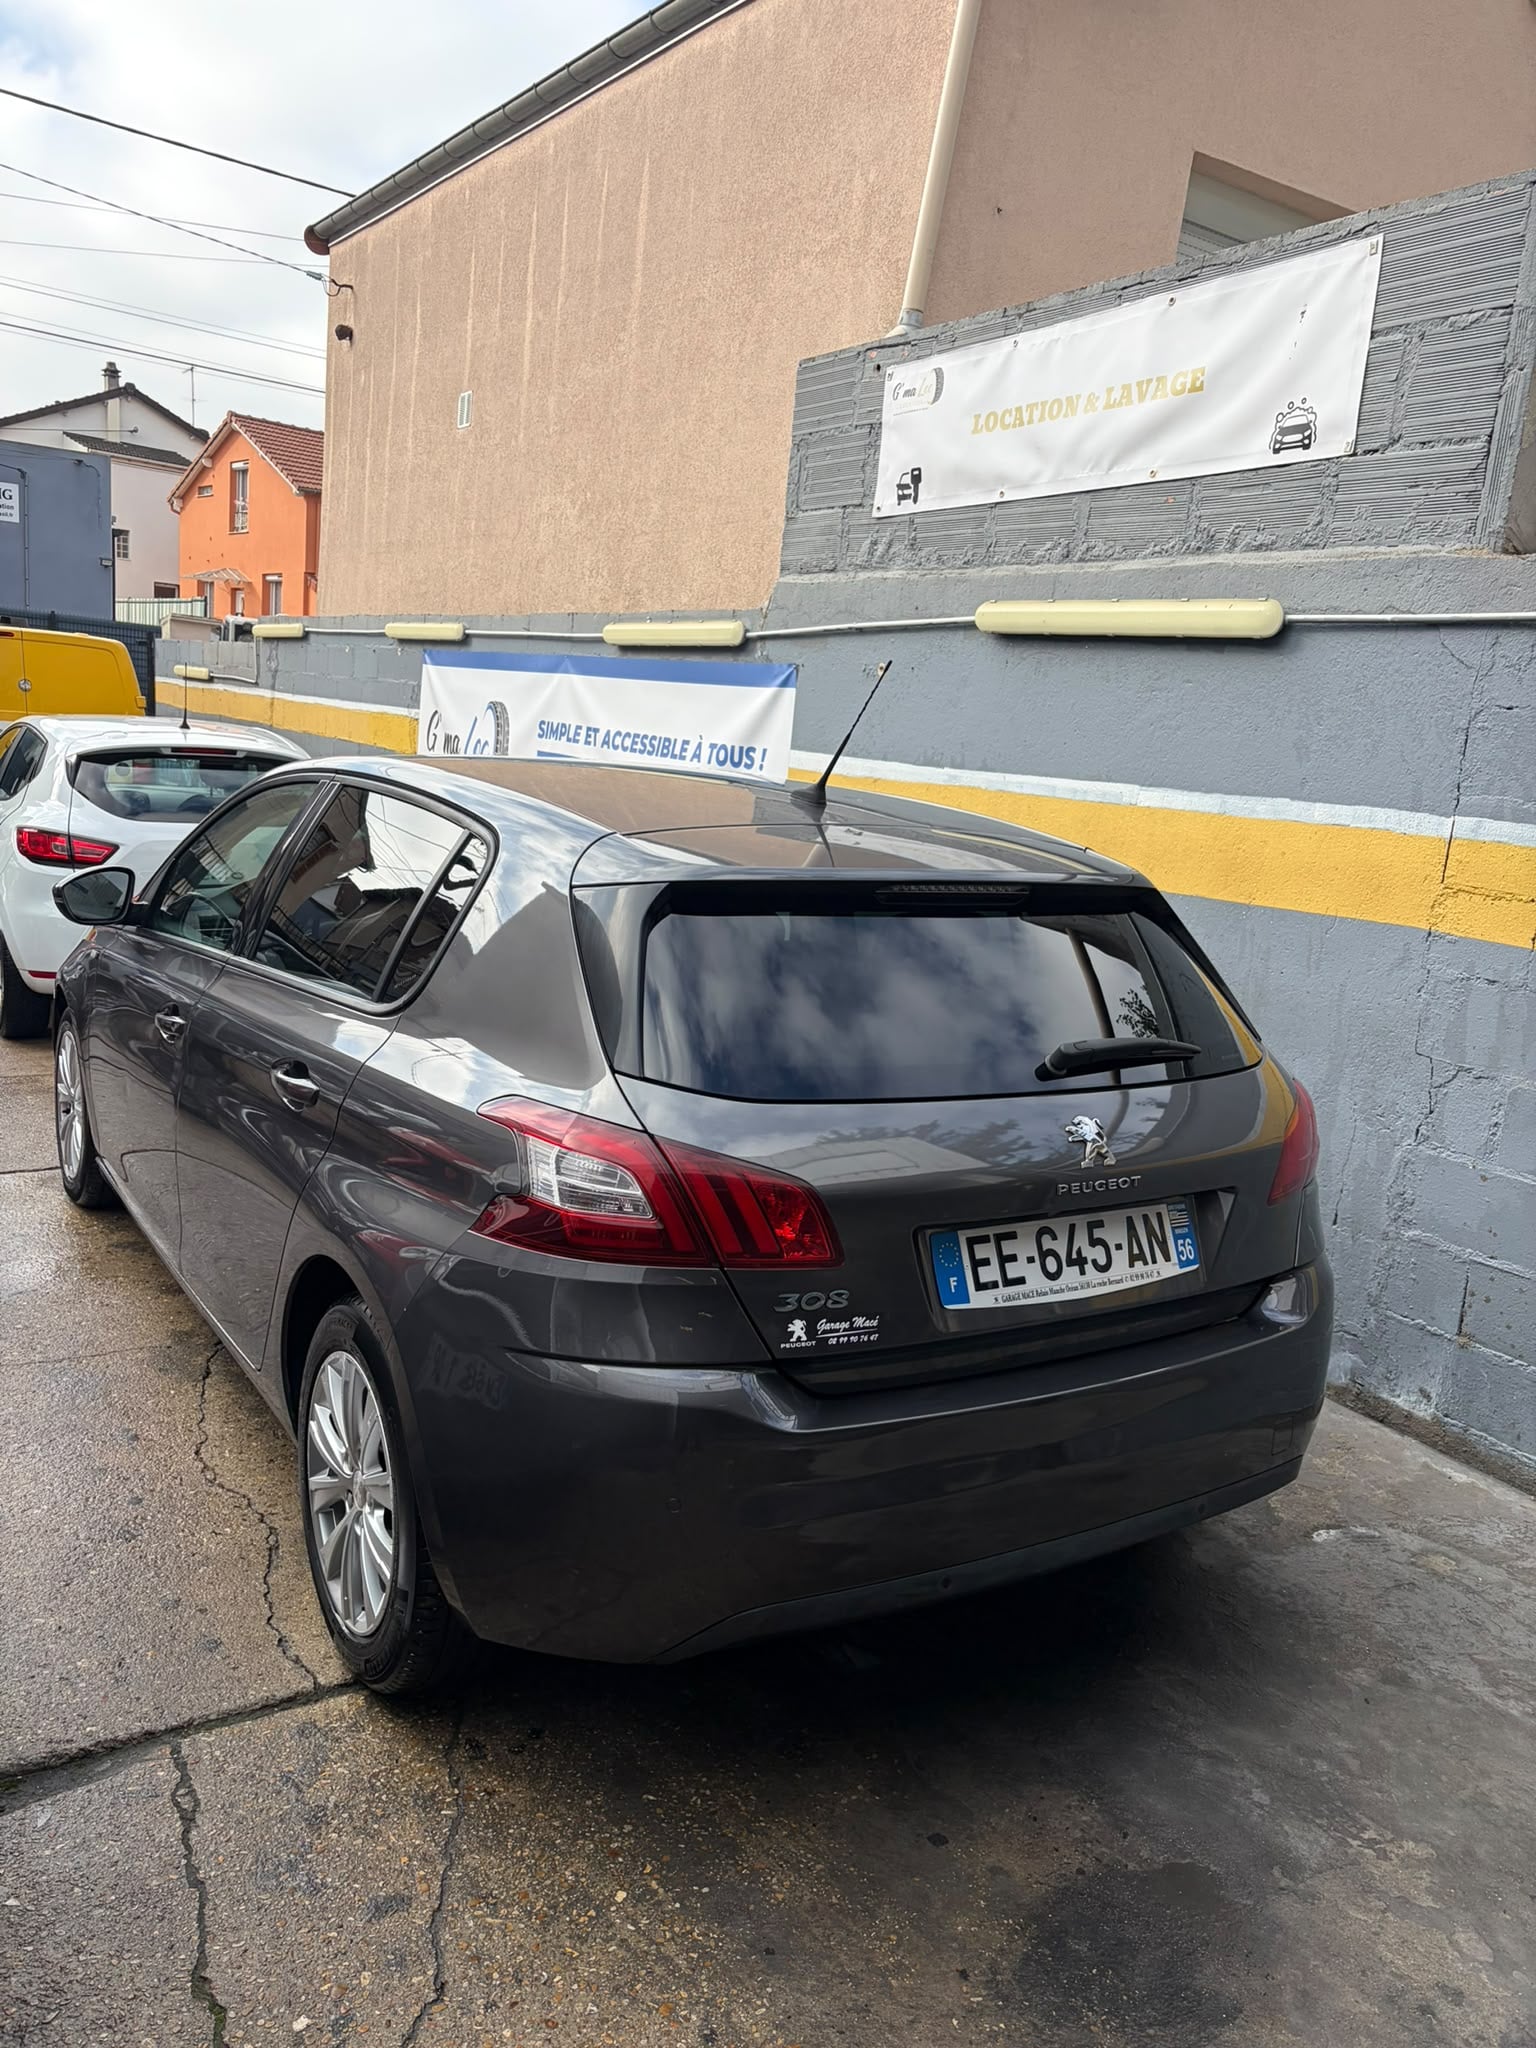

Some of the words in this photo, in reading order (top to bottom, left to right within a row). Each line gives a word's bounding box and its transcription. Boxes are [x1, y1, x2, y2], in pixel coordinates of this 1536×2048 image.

[971, 393, 1082, 435] LOCATION
[1083, 391, 1101, 415] &
[1102, 366, 1206, 411] LAVAGE
[0, 487, 13, 500] G
[537, 719, 583, 744] SIMPLE
[584, 726, 600, 747] ET
[600, 729, 690, 761] ACCESSIBLE
[690, 734, 703, 763] À
[1056, 1175, 1142, 1196] PEUGEOT
[949, 1277, 958, 1294] F
[965, 1210, 1172, 1293] EE-645-AN
[1177, 1238, 1195, 1261] 56
[773, 1289, 850, 1312] 308
[816, 1318, 850, 1334] Garage
[780, 1340, 816, 1349] PEUGEOT
